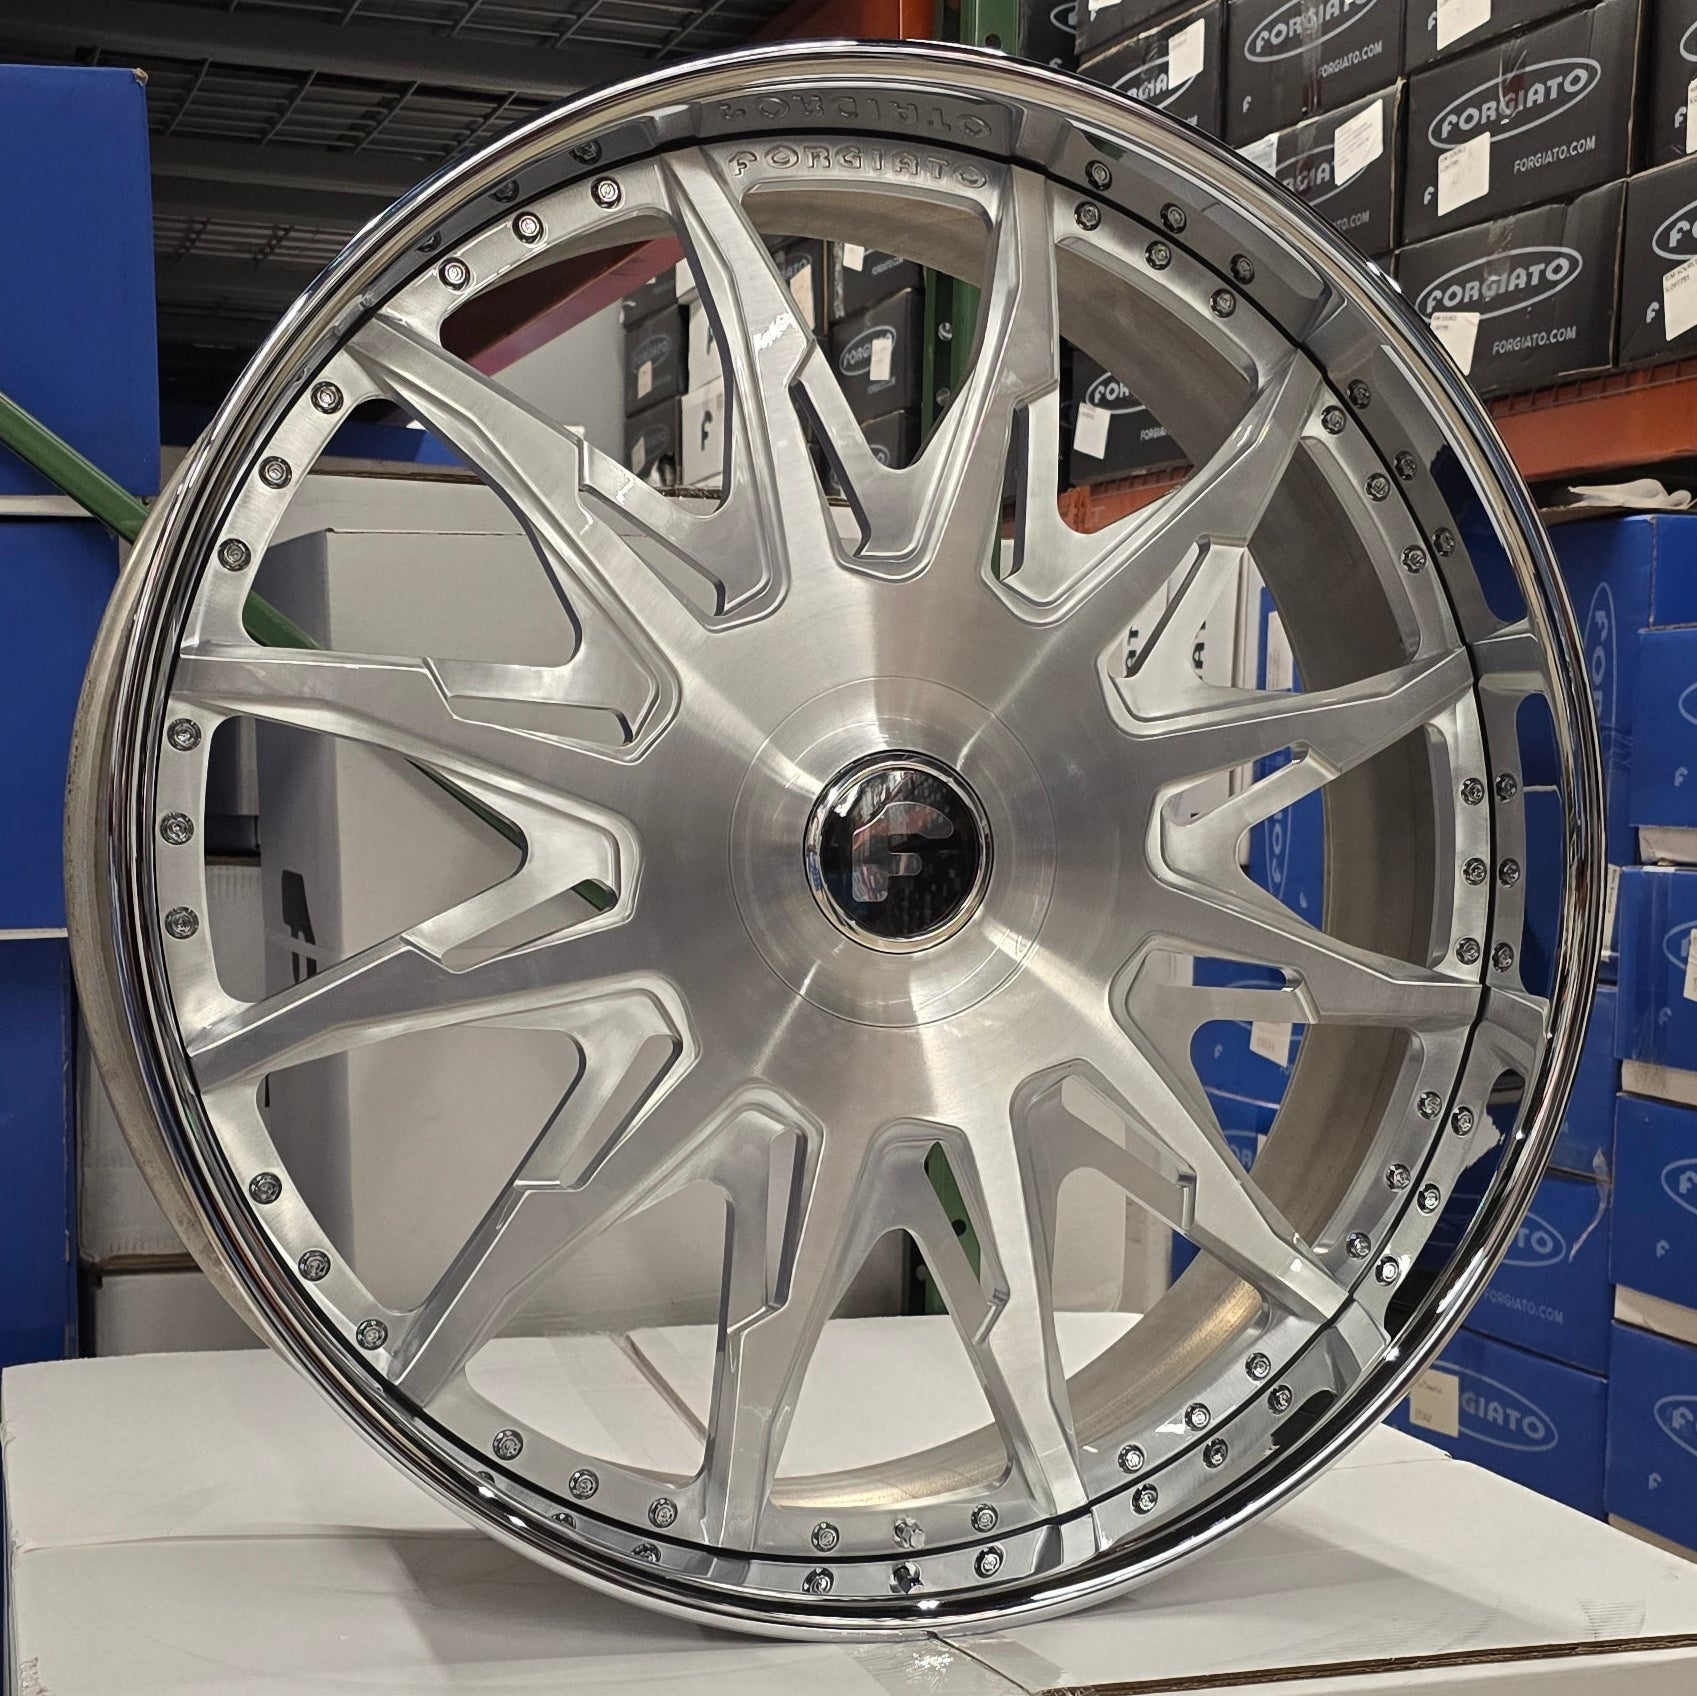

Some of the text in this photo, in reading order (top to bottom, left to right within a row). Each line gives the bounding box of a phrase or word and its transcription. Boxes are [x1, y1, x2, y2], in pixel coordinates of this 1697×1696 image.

[1255, 0, 1366, 53] FORGIA
[1441, 68, 1589, 139] FORGIATO
[727, 144, 987, 189] FORGIATO
[1513, 135, 1597, 175] FORGIATO.COM
[1426, 257, 1570, 314] FORGIATO
[1492, 325, 1577, 356] FORGIATO.COM
